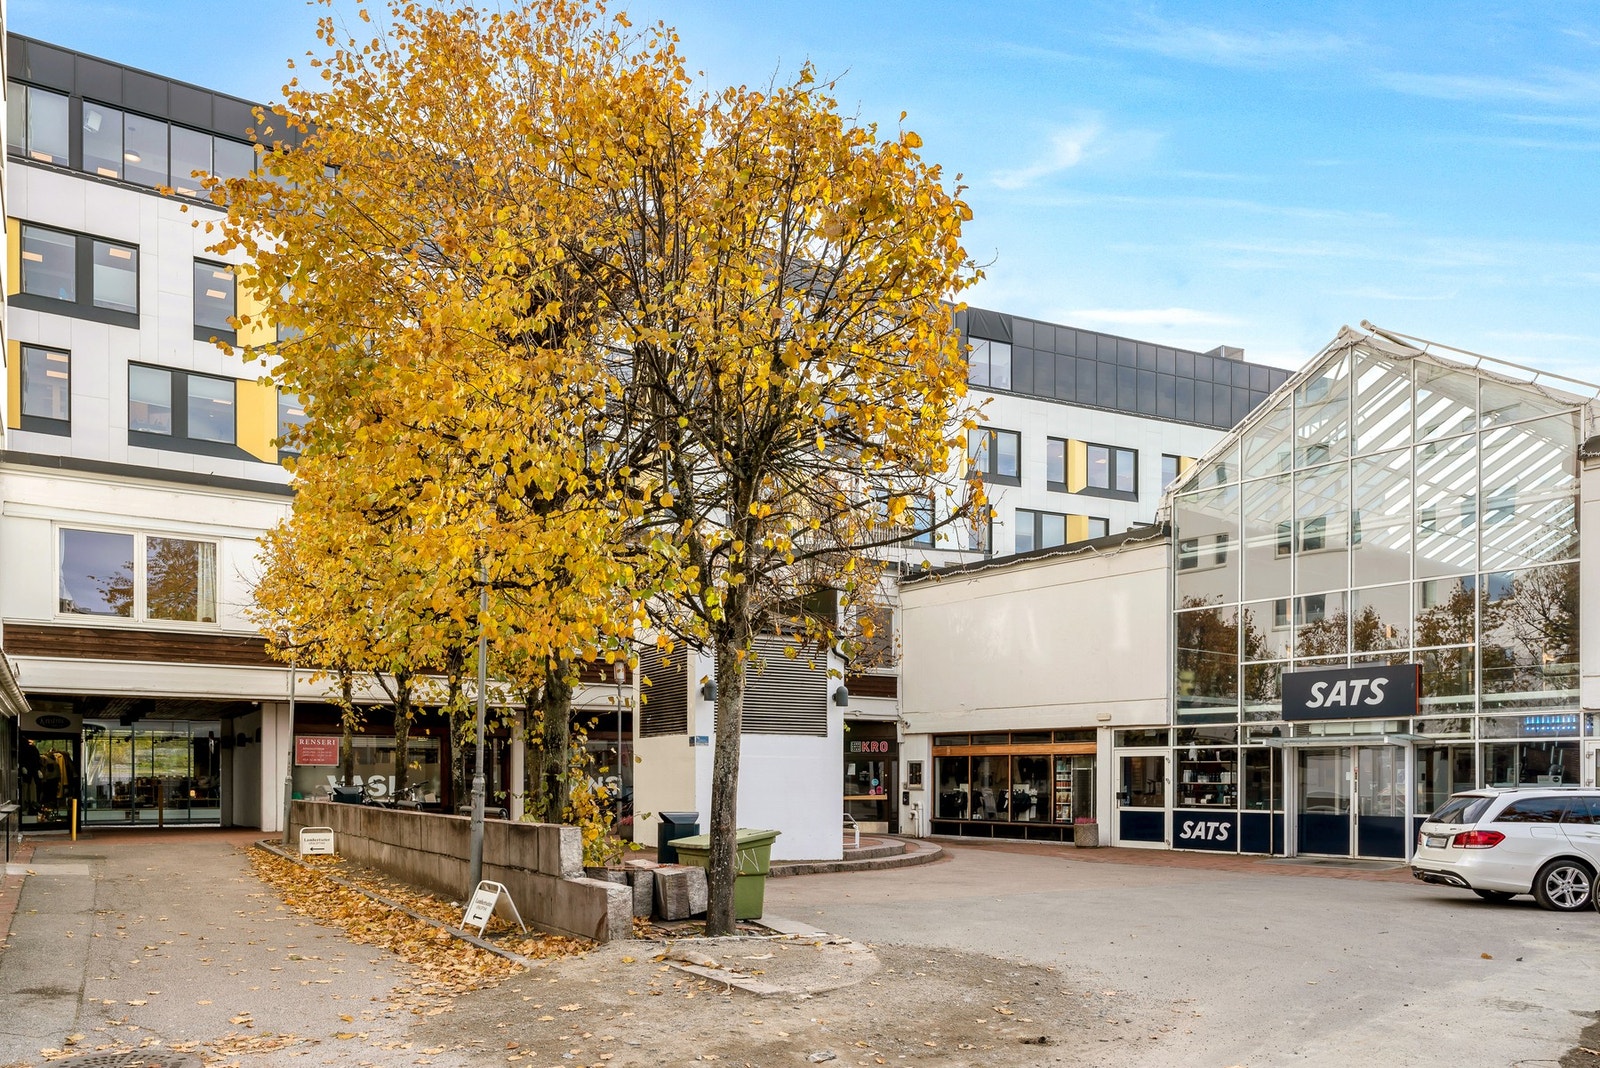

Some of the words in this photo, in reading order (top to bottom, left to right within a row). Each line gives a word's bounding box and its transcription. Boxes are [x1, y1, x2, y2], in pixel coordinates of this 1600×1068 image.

[1305, 677, 1389, 708] SATS
[299, 738, 336, 746] RENSERI
[861, 740, 888, 753] KRO
[1179, 820, 1232, 841] SATS
